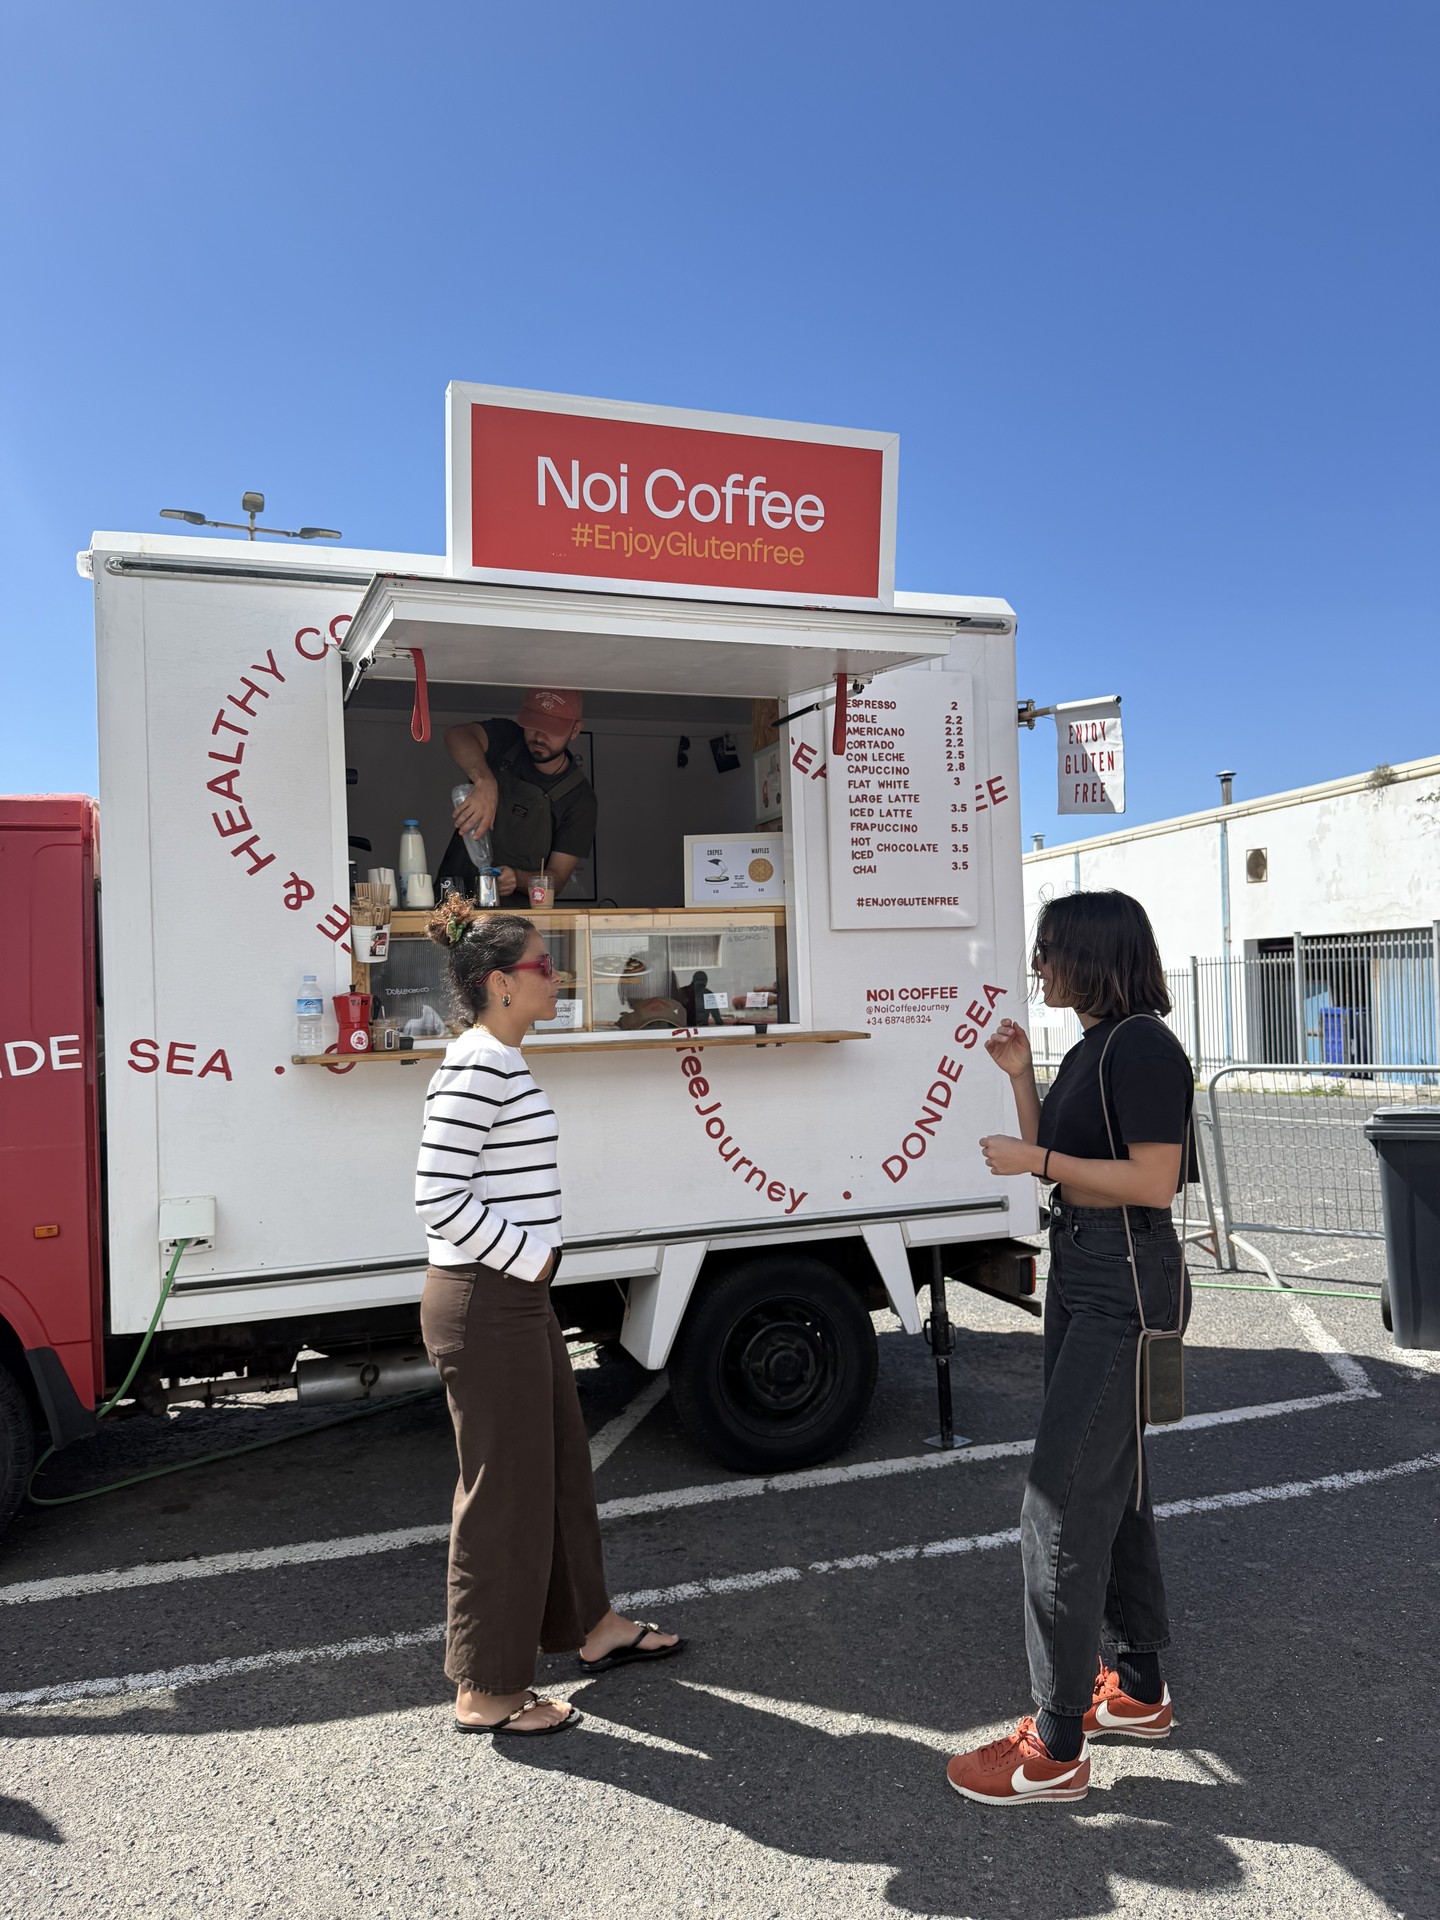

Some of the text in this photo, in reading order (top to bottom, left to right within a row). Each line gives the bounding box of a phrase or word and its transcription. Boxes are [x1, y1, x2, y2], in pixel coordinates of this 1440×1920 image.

[537, 456, 825, 532] Noi Coffee
[571, 522, 805, 566] #EnjoyGlutenfree
[846, 700, 958, 710] ESPRESSO 2
[846, 714, 963, 725] DOBLE 2.2
[846, 727, 963, 737] AMERICANO 2.2
[1068, 721, 1107, 744] ENJOY
[846, 738, 964, 750] CORTADO 2.2
[207, 649, 286, 875] HEALTHY
[846, 751, 965, 762] CON LECHE 2.5
[1065, 750, 1115, 774] GLUTEN
[847, 762, 965, 775] CAPUCCINO 2.8
[848, 777, 961, 789] FLAT WHITE 3
[1075, 782, 1106, 803] FREE
[849, 794, 967, 813] LARGE LATTE 3.5
[850, 808, 913, 818] ICED LATTE
[850, 822, 969, 833] FRAPUCCINO 5.5
[851, 837, 871, 846] HOT
[876, 843, 969, 853] CHOCOLATE 3.5
[852, 850, 874, 860] ICED
[853, 861, 969, 874] CHAI 3.5
[856, 896, 959, 907] #ENJOYGLUTENFREE
[866, 986, 958, 1002] NOI COFFEE
[866, 1004, 950, 1015] @NoiCoffeeJourney
[866, 1015, 931, 1025] +34 687486324
[0, 1034, 83, 1079] DE
[127, 1039, 233, 1081] SEA
[881, 984, 1008, 1183] DONDE SEA
